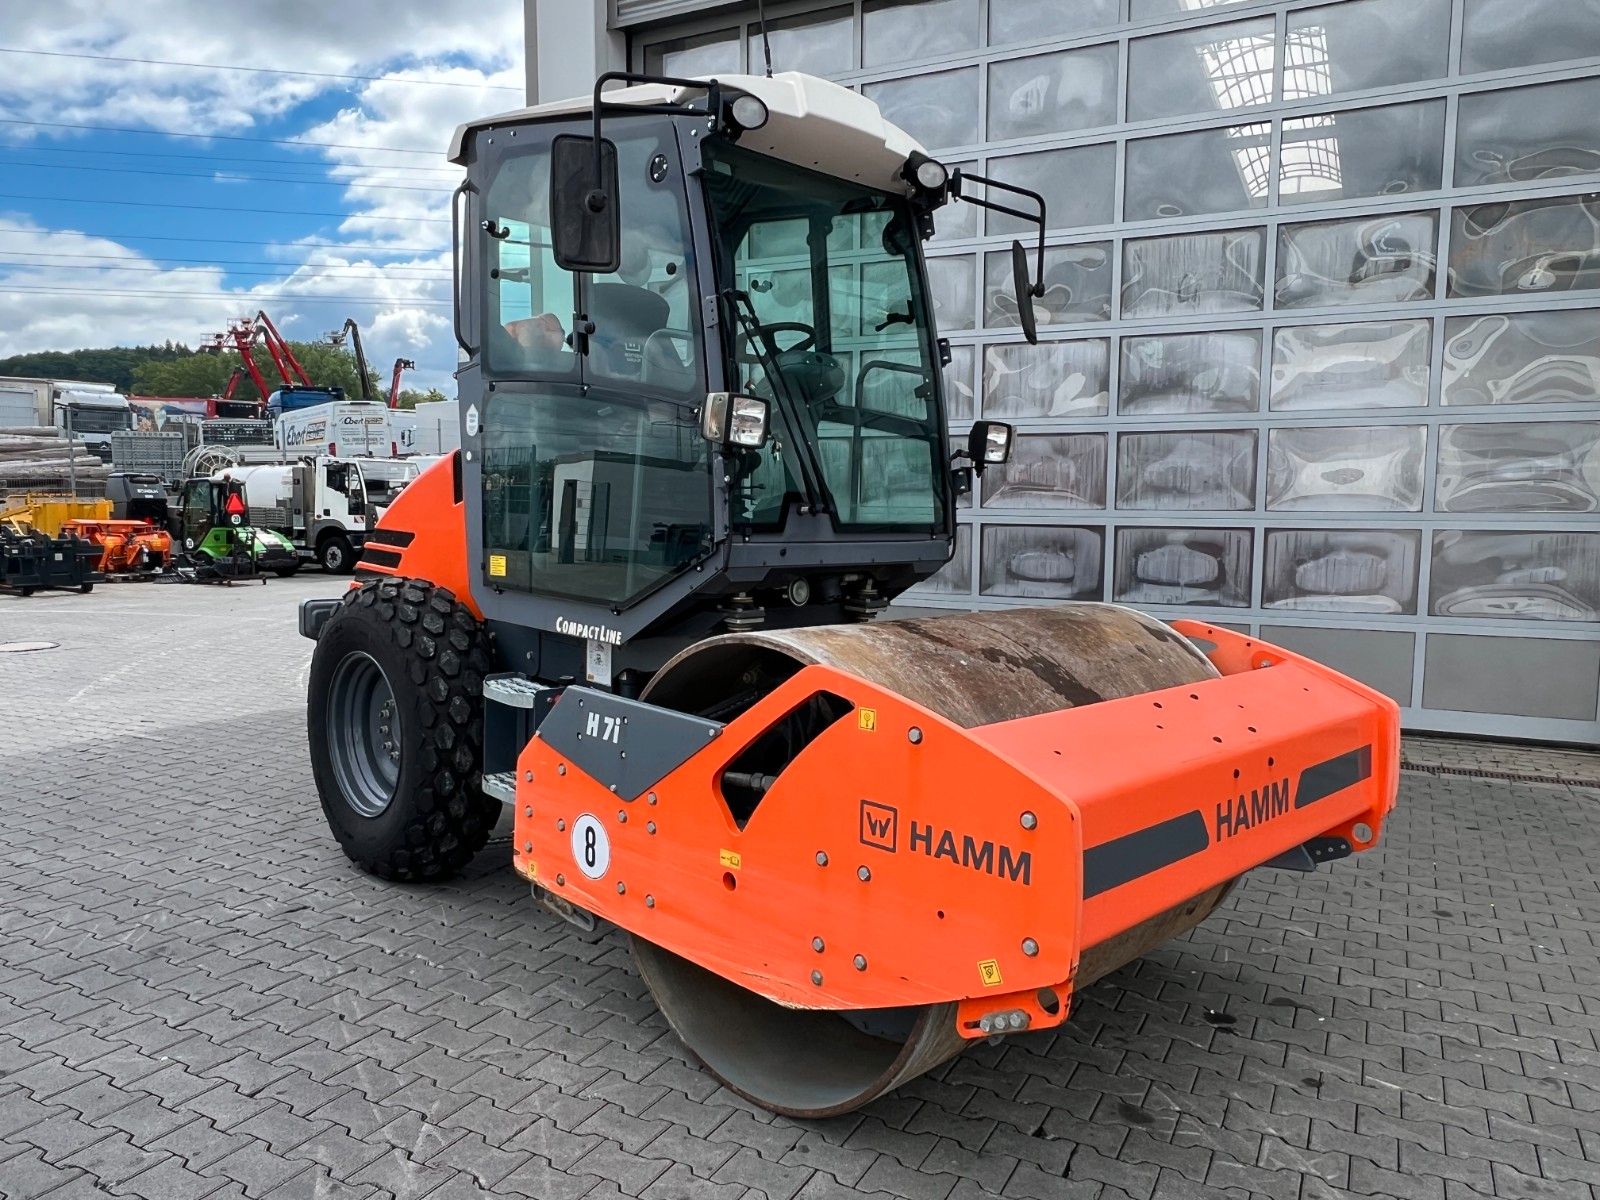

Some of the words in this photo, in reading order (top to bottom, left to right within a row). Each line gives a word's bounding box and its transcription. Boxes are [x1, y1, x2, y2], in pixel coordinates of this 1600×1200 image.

[586, 711, 600, 738] H
[603, 716, 621, 744] 7i
[1216, 777, 1289, 843] HAMM
[585, 825, 597, 868] 8
[910, 820, 1032, 886] HAMM
